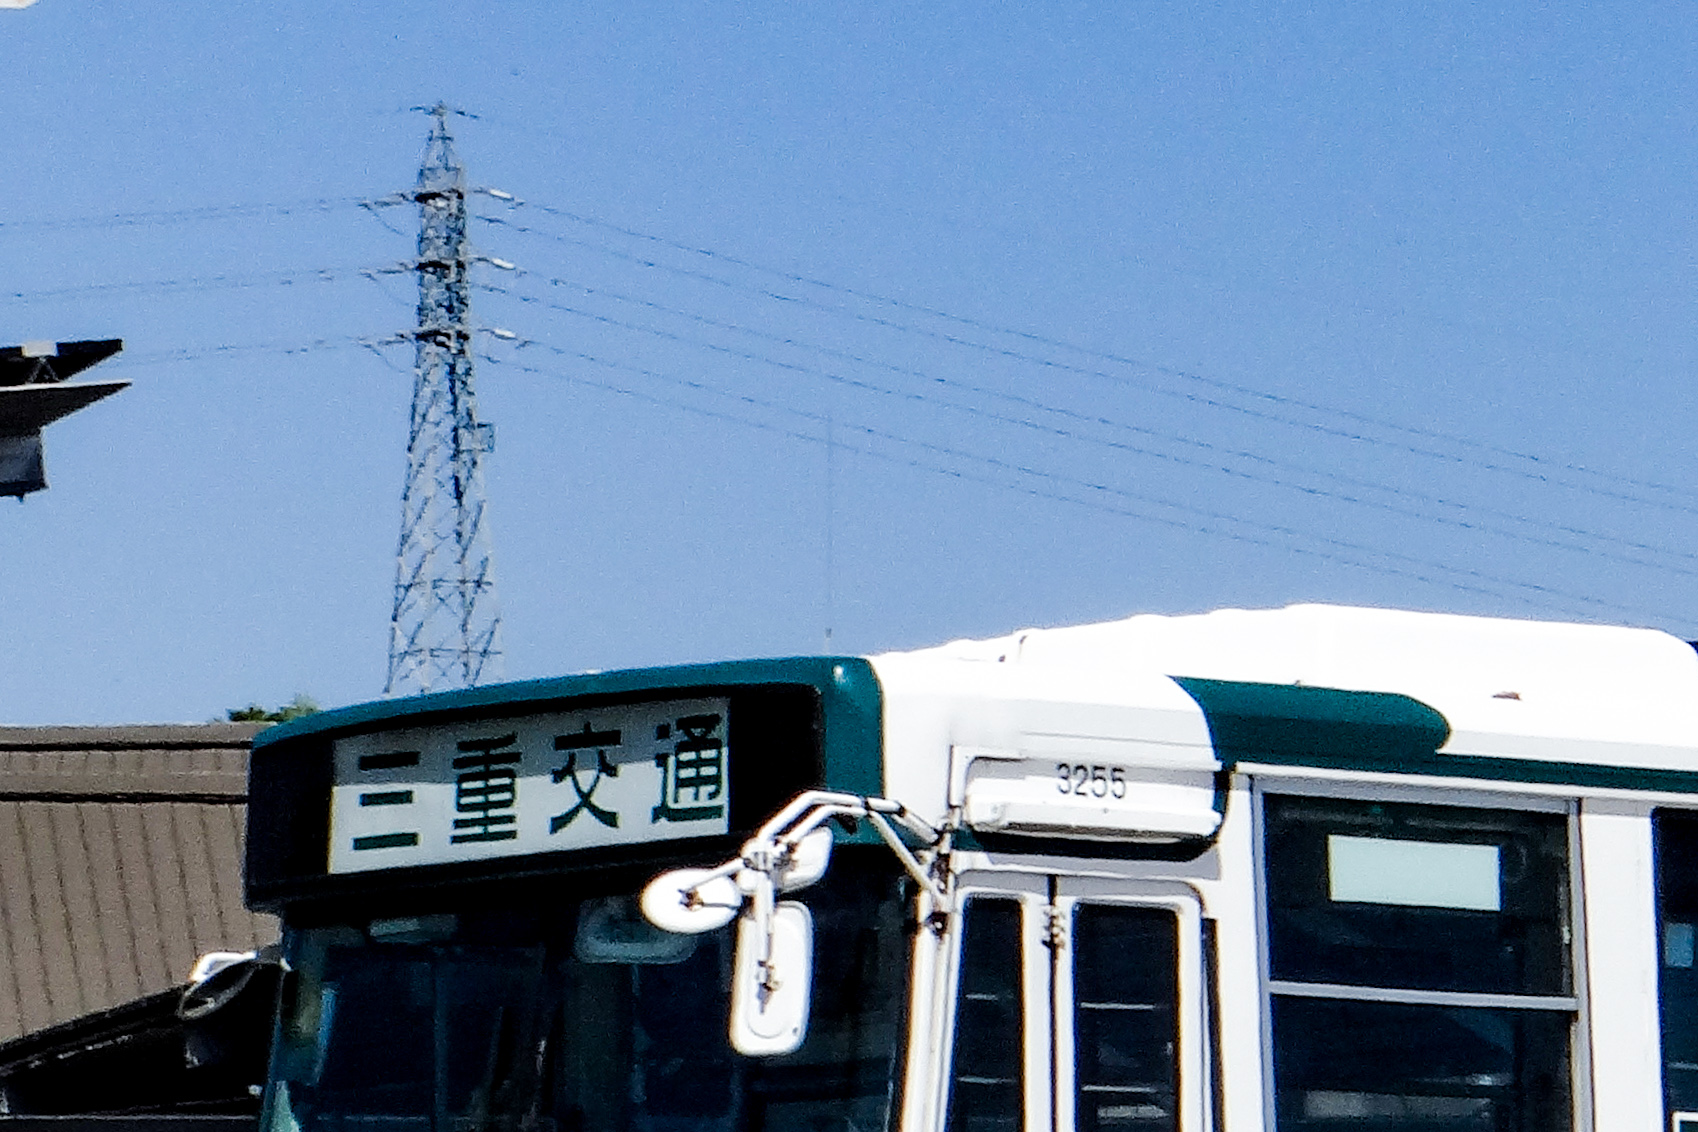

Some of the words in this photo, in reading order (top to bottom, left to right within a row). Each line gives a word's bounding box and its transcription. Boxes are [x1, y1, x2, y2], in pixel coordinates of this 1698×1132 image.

[353, 713, 723, 851] 三重交通
[1056, 763, 1126, 799] 3255
